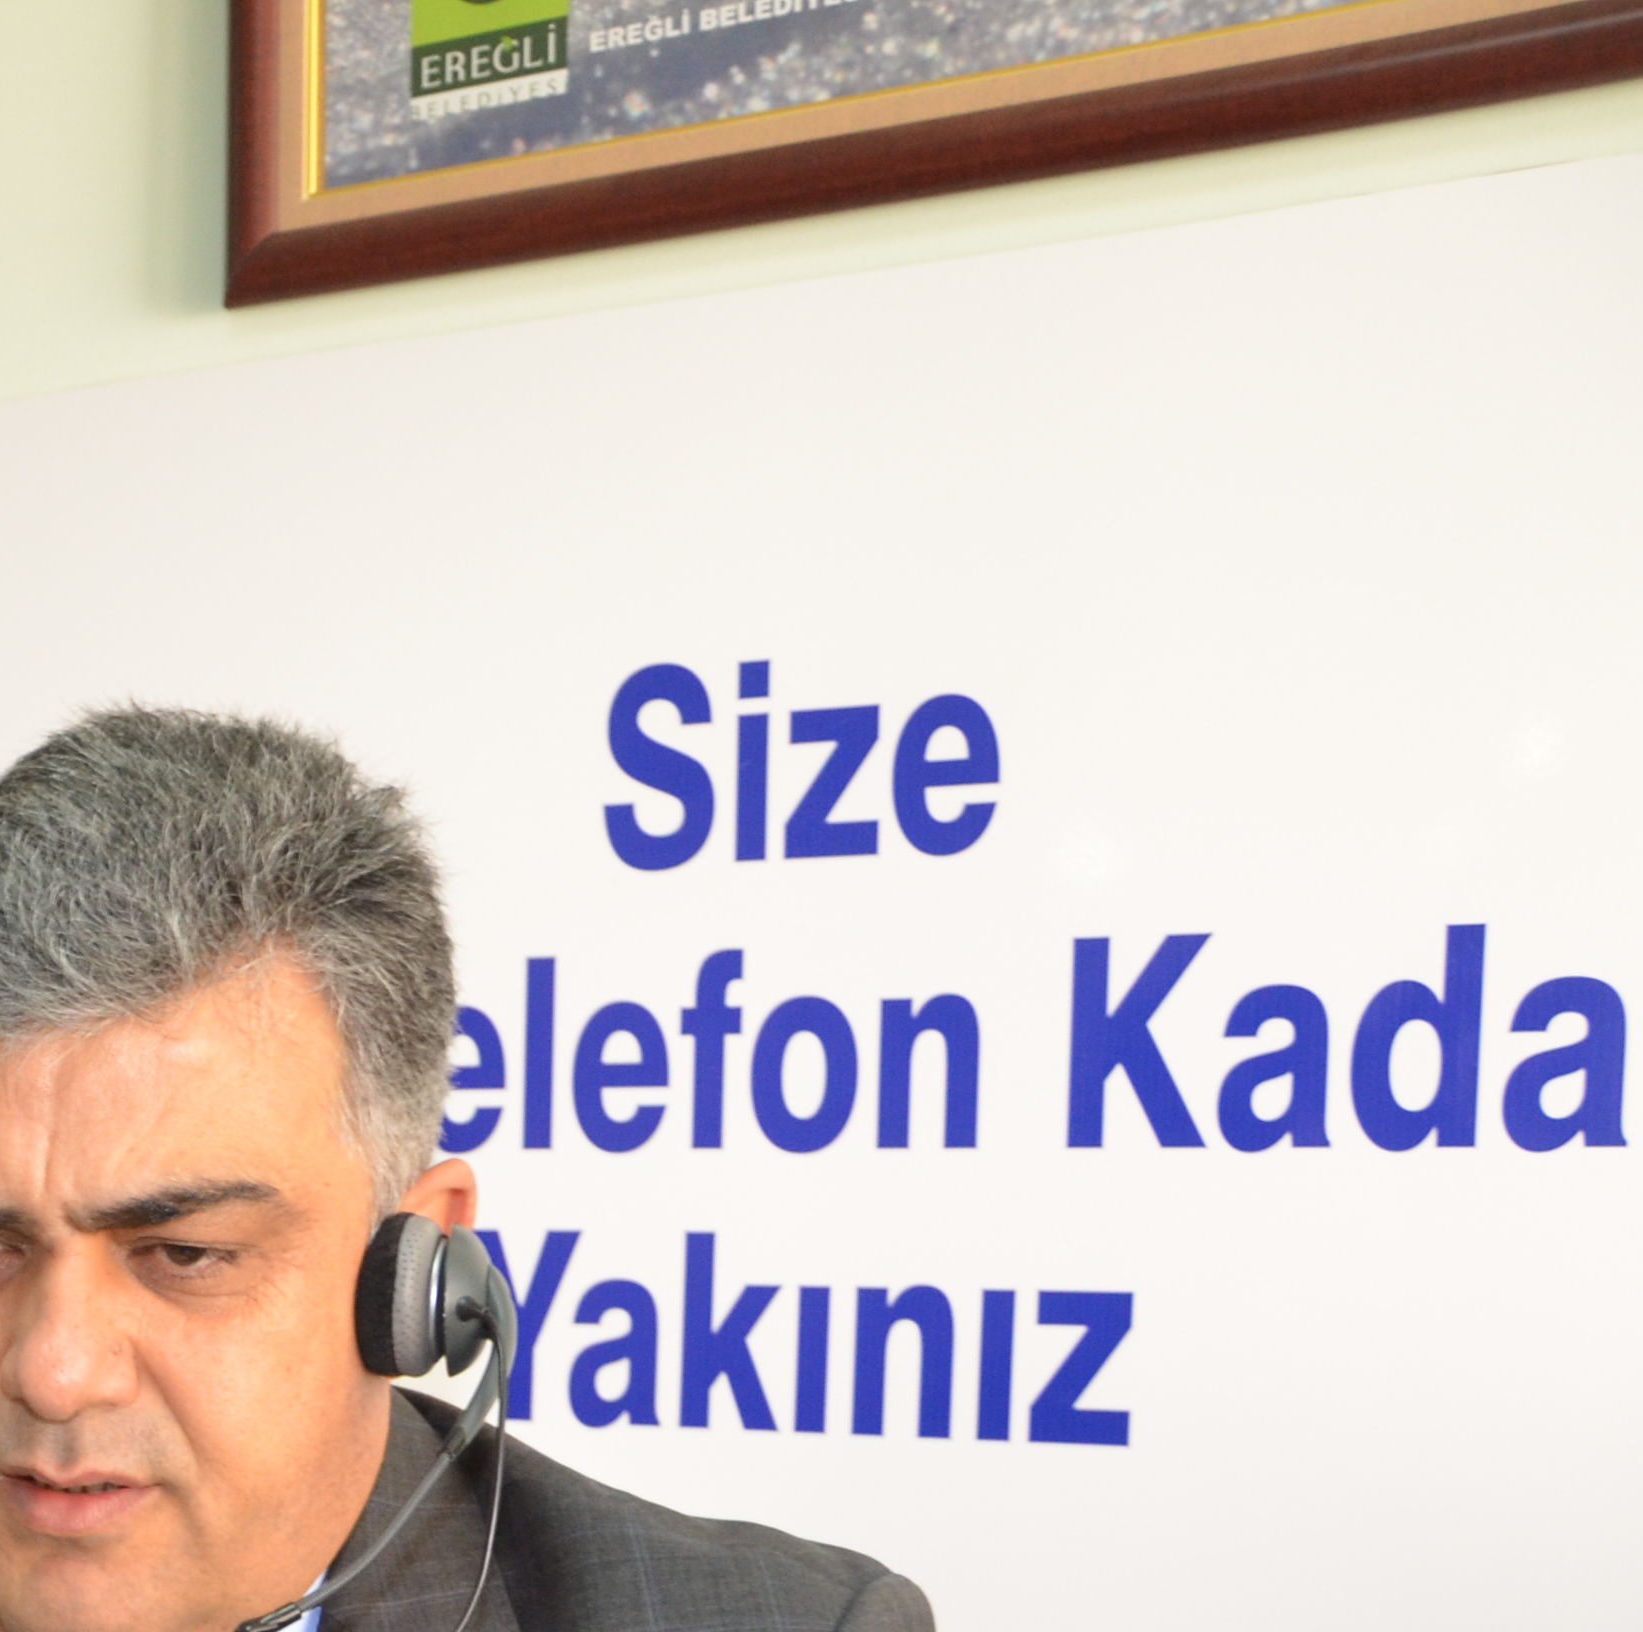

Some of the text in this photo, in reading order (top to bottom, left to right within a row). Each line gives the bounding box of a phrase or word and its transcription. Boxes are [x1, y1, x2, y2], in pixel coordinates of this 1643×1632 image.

[588, 8, 692, 52] EREĞLİ
[602, 659, 1002, 871] Size
[439, 948, 982, 1154] elefon
